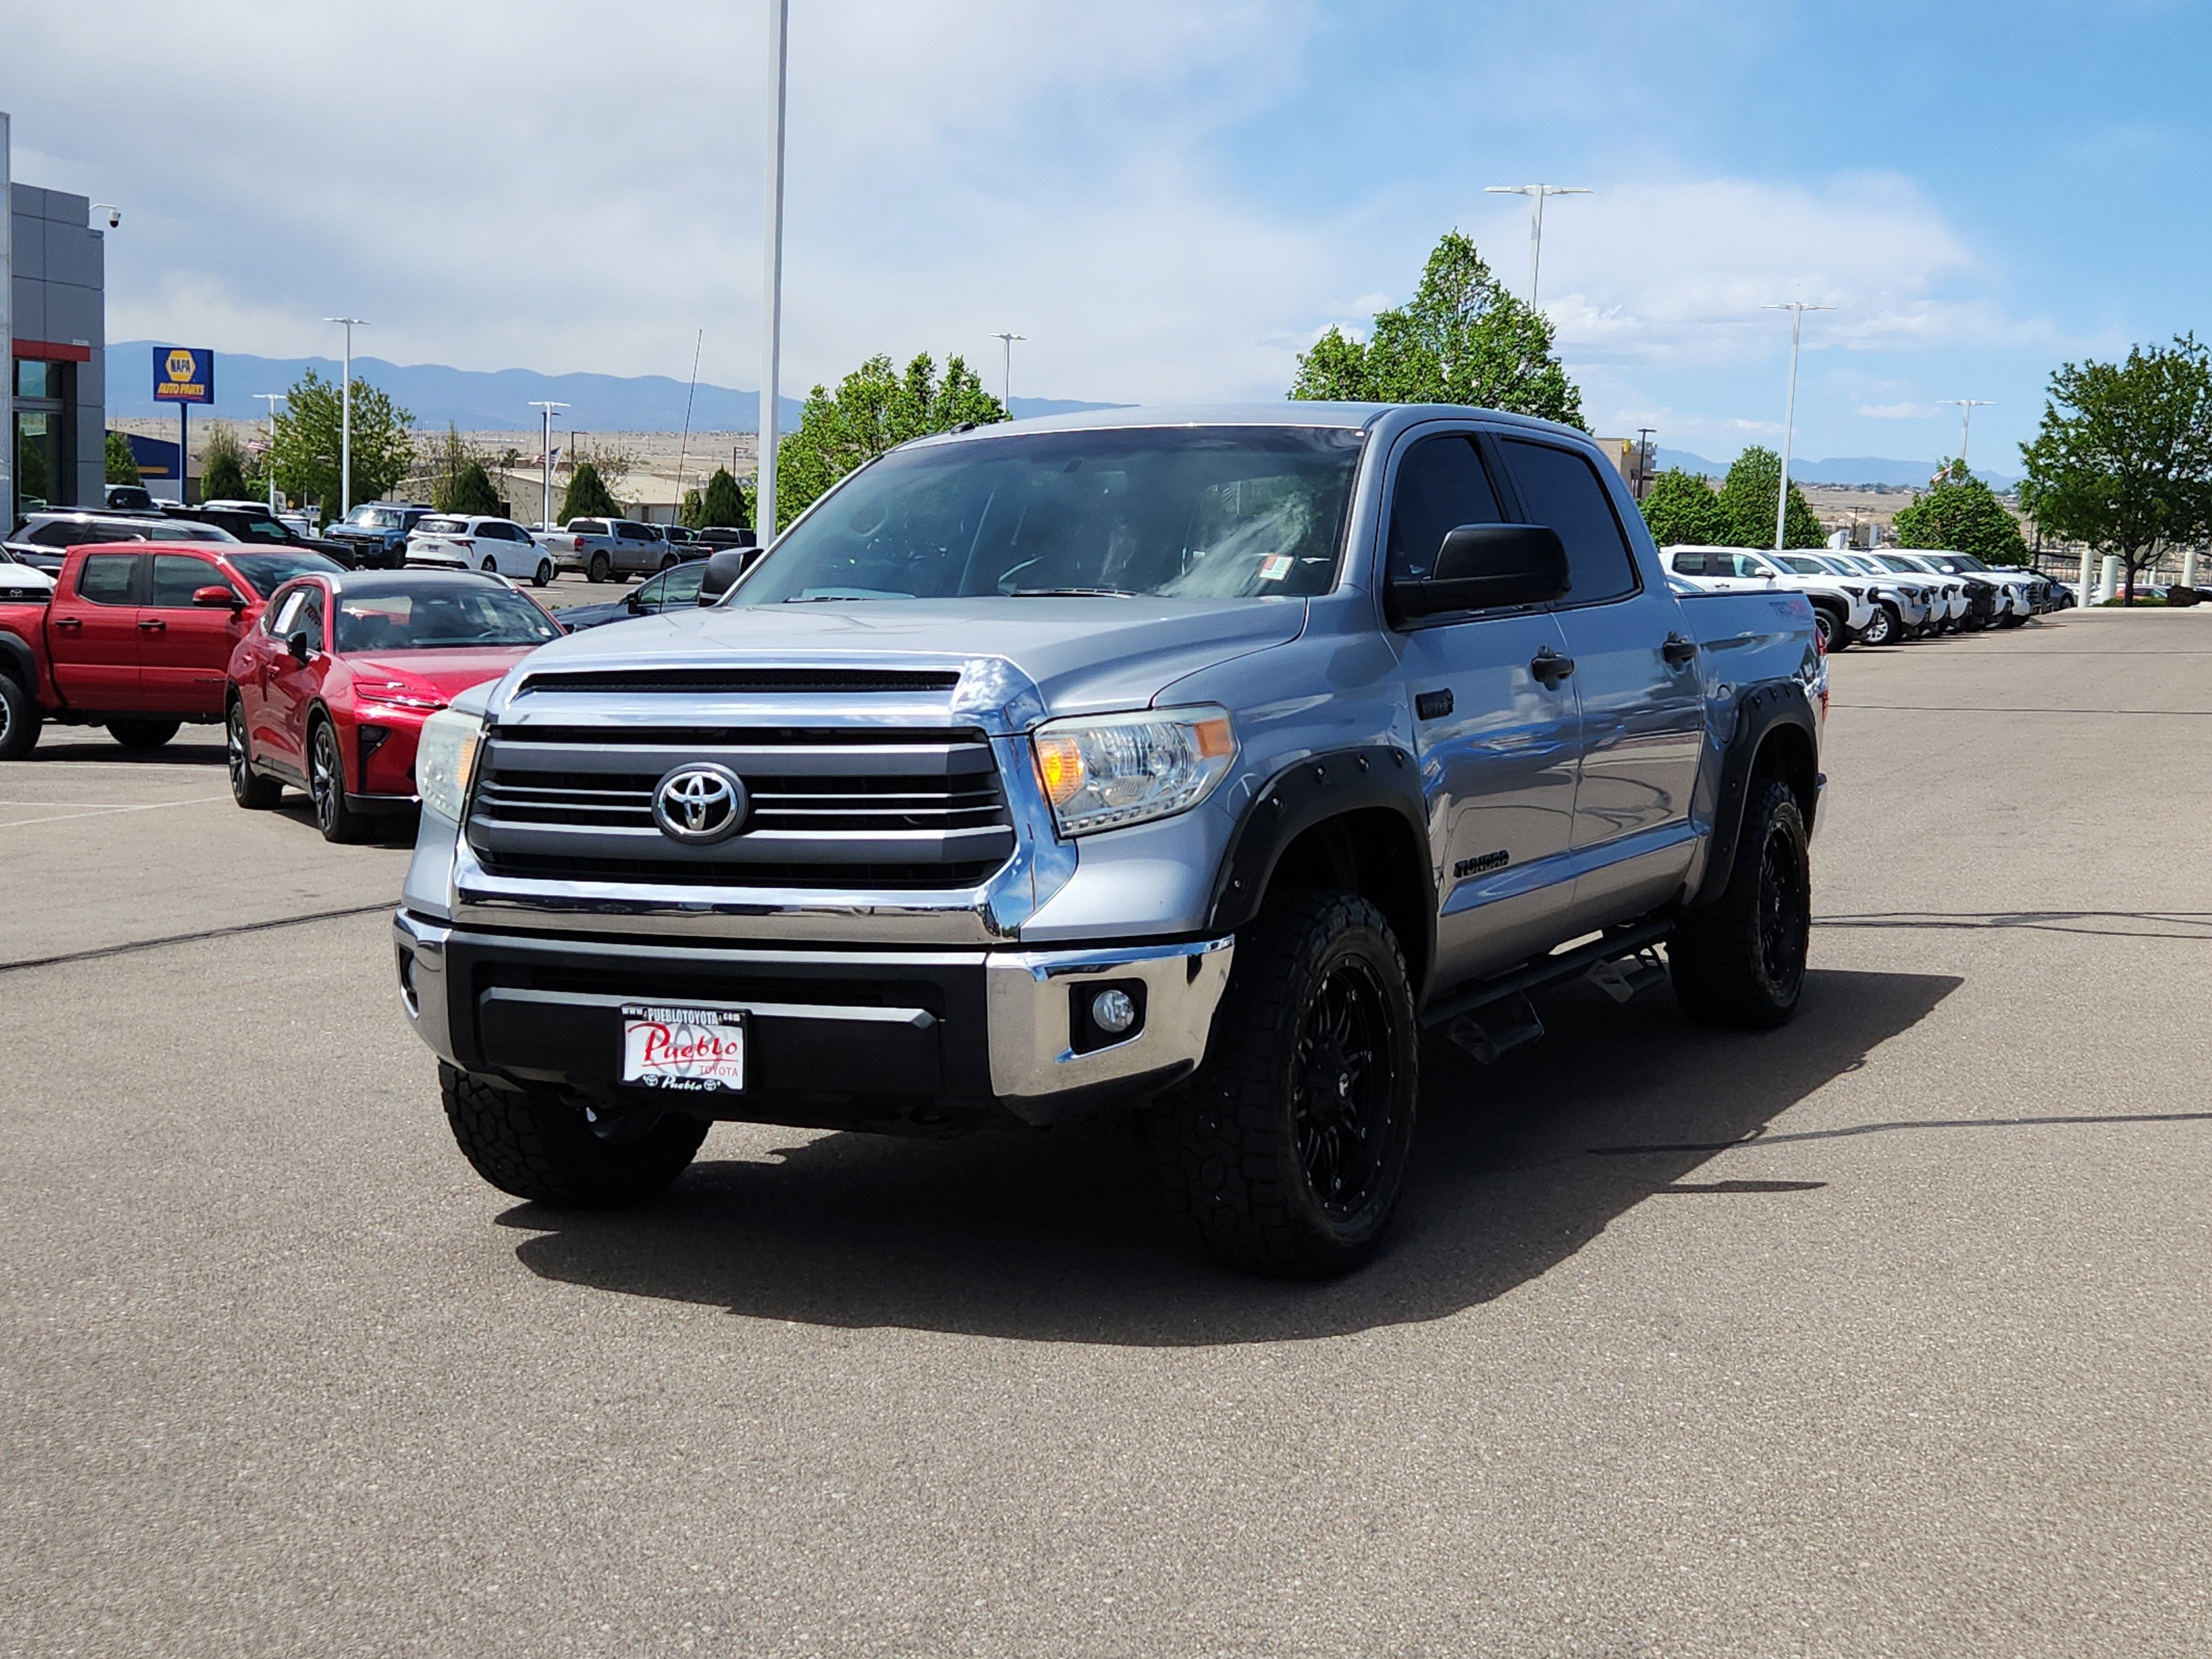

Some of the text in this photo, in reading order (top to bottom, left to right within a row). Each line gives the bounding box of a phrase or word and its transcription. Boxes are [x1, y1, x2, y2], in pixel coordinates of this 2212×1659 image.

[170, 359, 191, 373] NAPA
[157, 383, 205, 396] AUTO PARTS
[627, 1022, 738, 1063] Pueblo
[699, 1065, 738, 1077] TOYOTA
[661, 1076, 702, 1090] Pueblo
